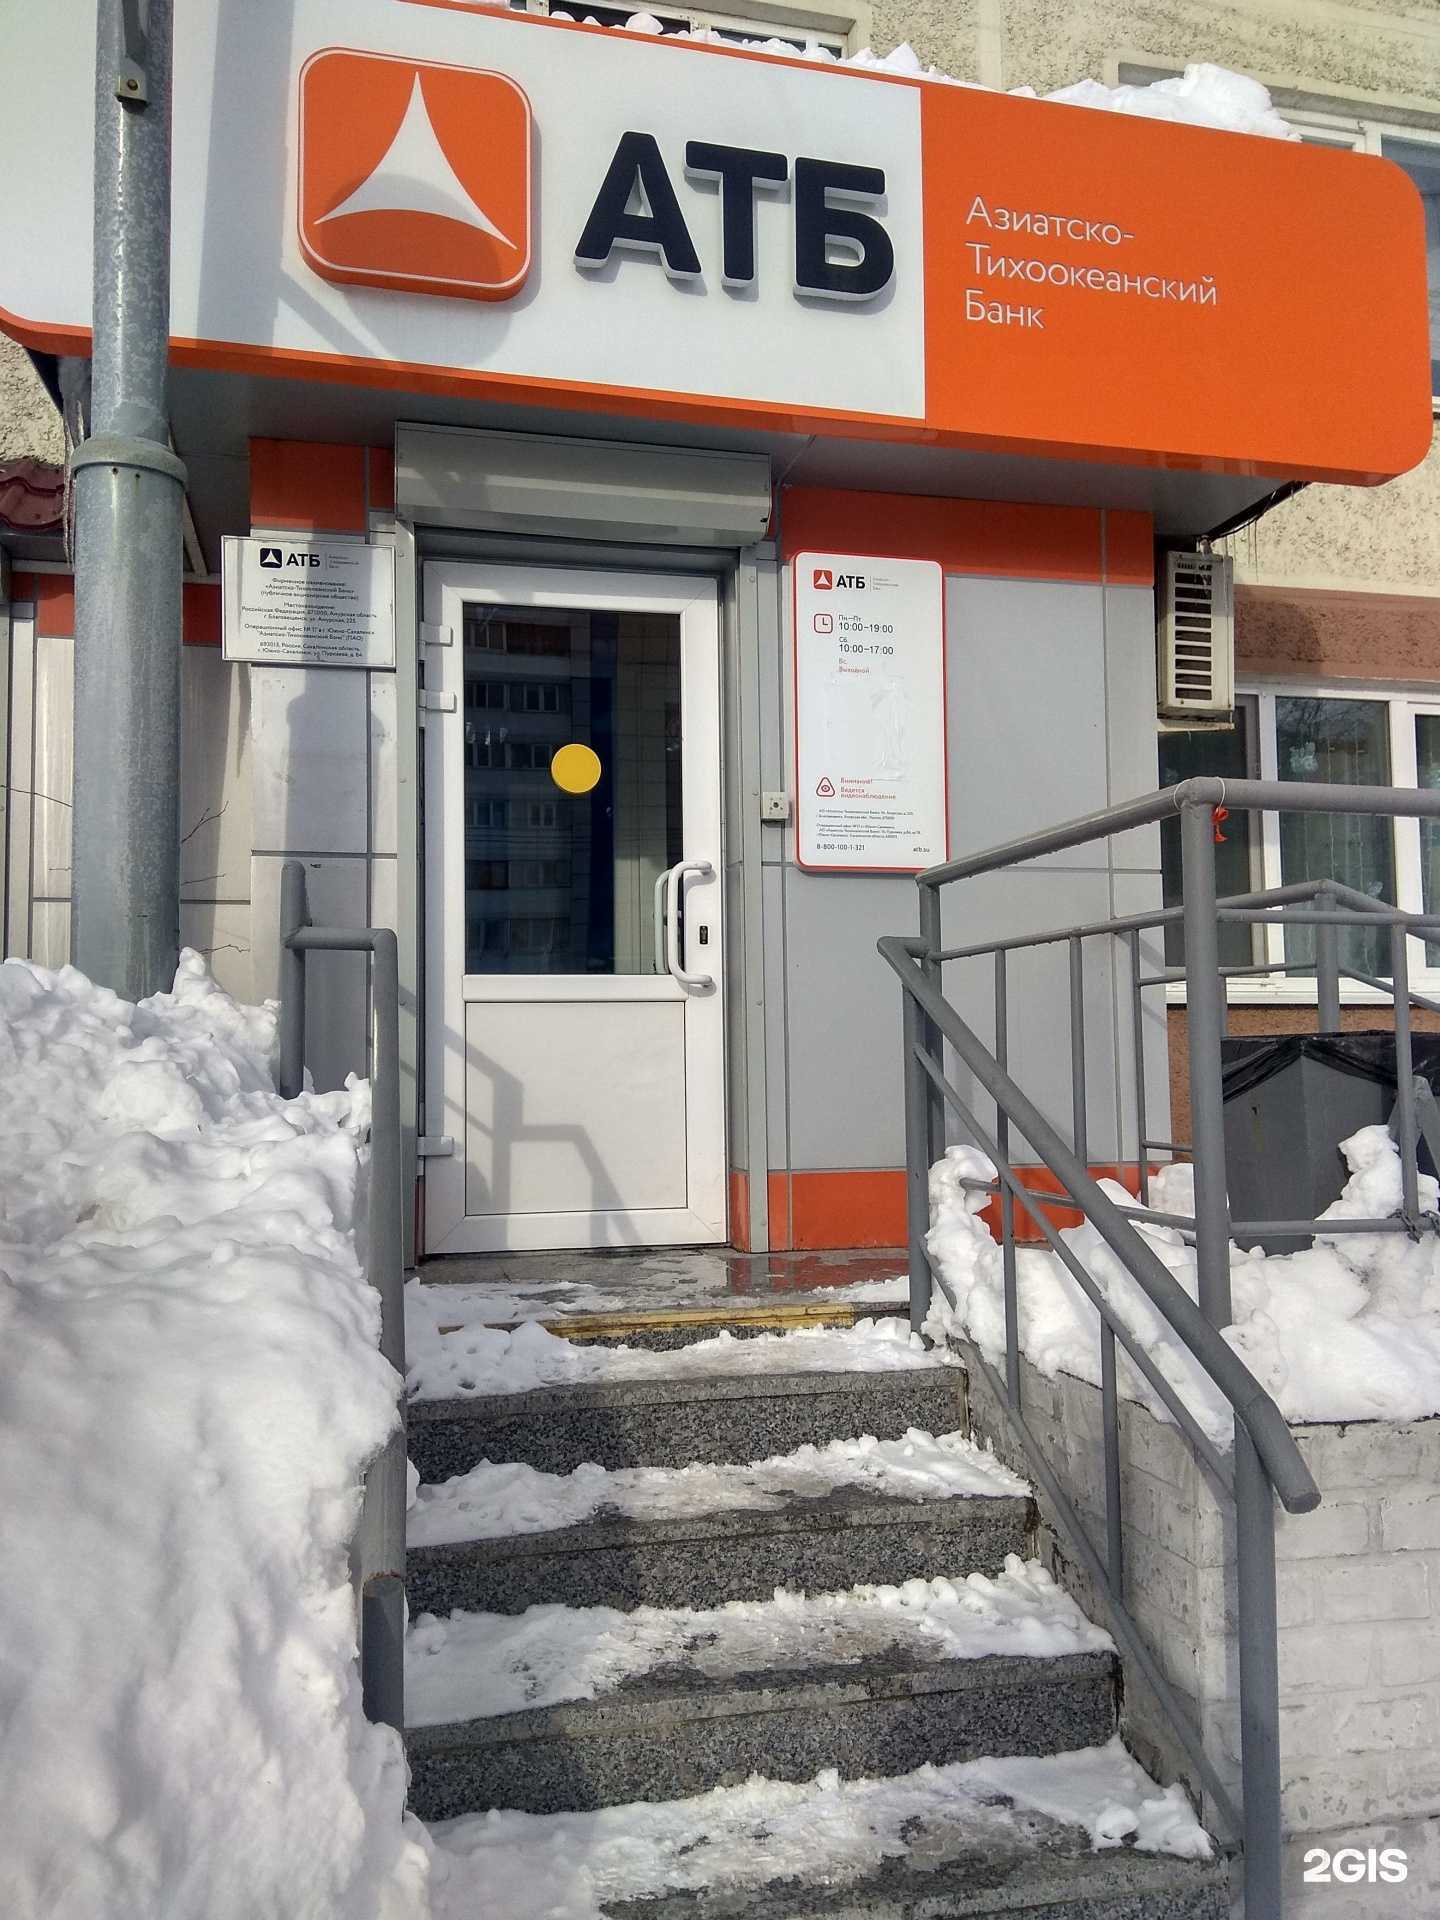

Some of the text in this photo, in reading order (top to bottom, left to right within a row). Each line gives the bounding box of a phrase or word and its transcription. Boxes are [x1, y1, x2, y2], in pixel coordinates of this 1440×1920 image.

[574, 130, 895, 300] АТБ
[965, 195, 1135, 246] Азиатско-
[964, 241, 1217, 306] Тихоокеанский
[964, 288, 1045, 329] Банк
[286, 553, 321, 568] АТБ
[836, 575, 866, 589] АТБ
